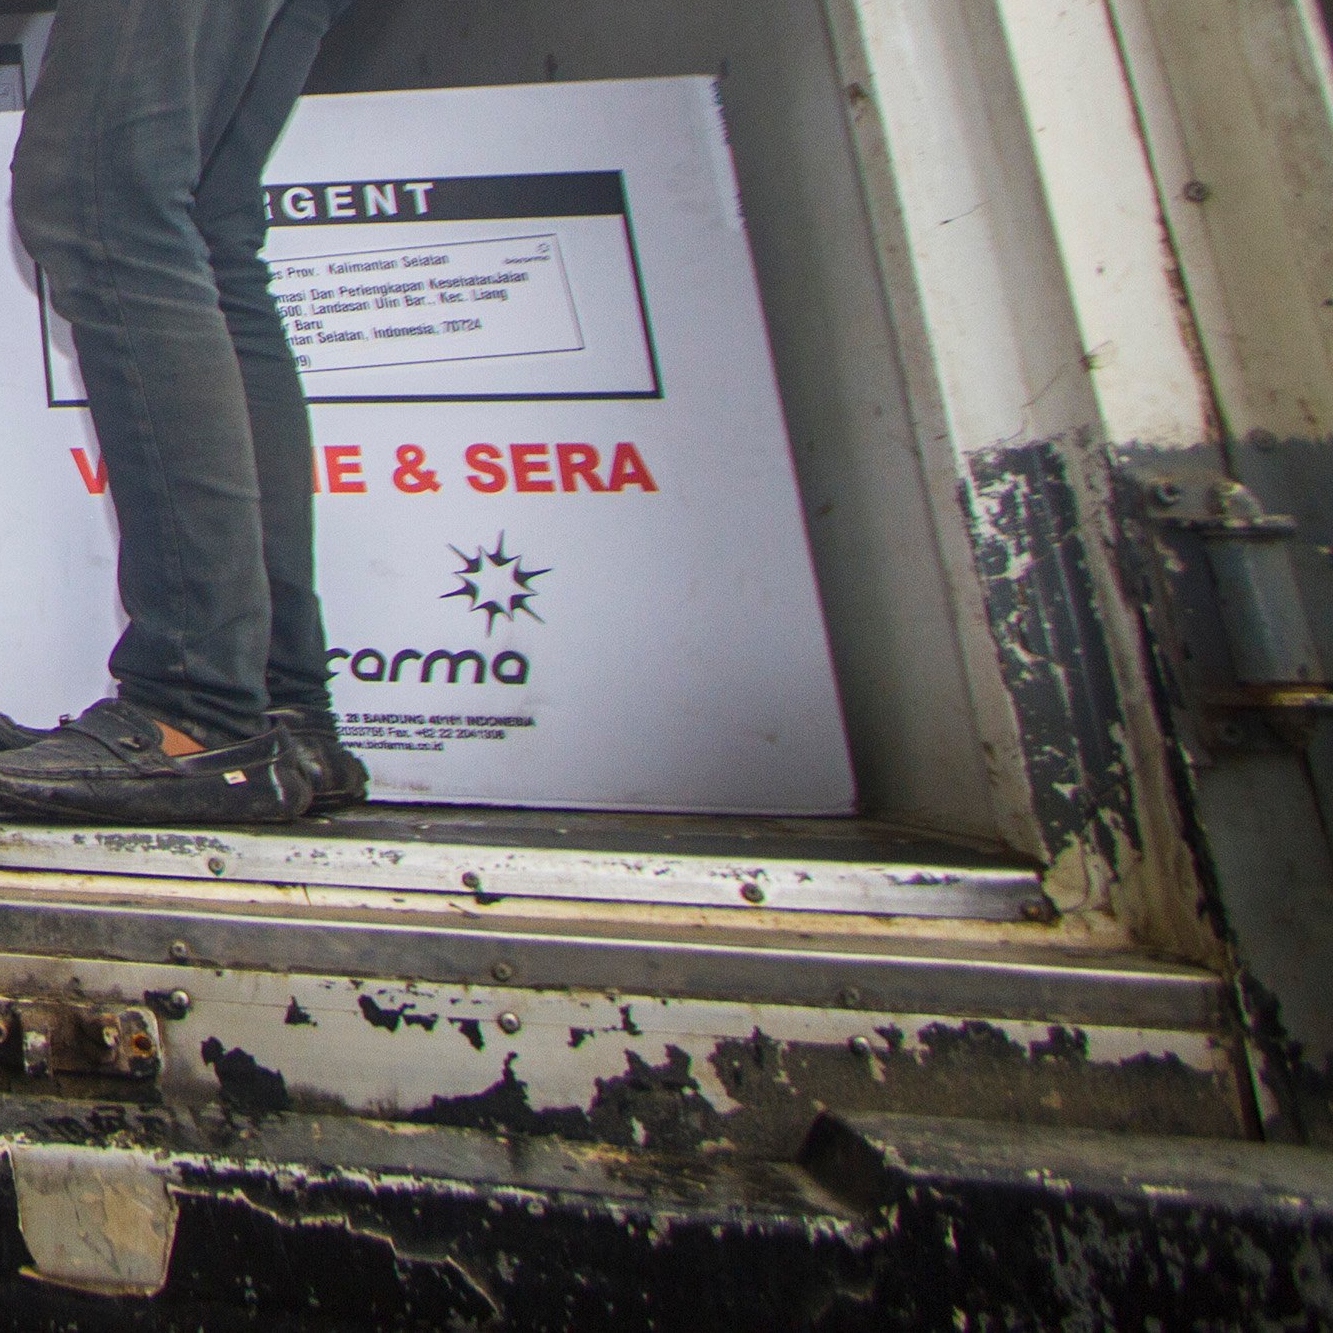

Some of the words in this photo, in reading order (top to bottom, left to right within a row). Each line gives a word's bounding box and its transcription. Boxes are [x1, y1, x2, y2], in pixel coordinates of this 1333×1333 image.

[262, 181, 434, 220] GENT
[328, 258, 397, 274] Kalimantan
[401, 254, 450, 268] Selatan
[310, 289, 335, 301] Dan
[312, 301, 370, 316] Landasan
[294, 319, 323, 331] Baru
[392, 443, 440, 494] &
[464, 442, 660, 494] SERA
